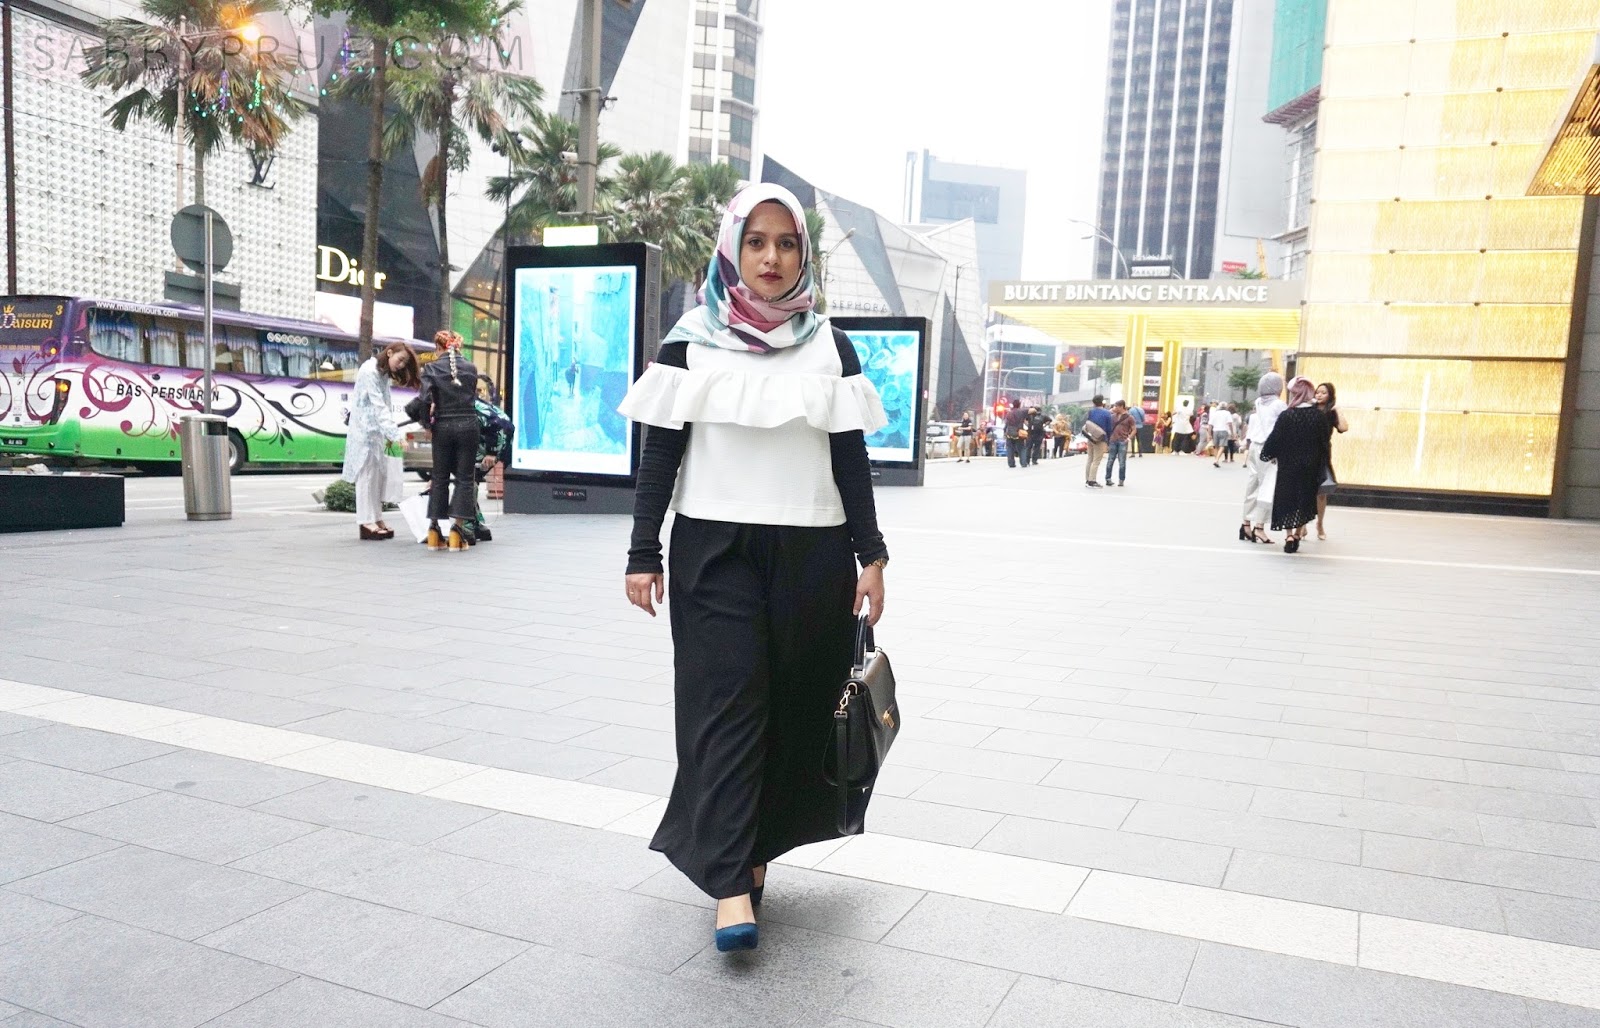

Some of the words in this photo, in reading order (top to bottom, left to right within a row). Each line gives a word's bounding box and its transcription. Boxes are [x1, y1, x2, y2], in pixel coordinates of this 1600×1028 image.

[1004, 285, 1061, 301] BUKIT
[1065, 285, 1152, 301] BINTANG
[1157, 285, 1268, 302] ENTRANCE
[55, 304, 63, 316] 3
[831, 300, 888, 313] SEPHORA
[116, 384, 142, 397] BAS
[151, 386, 220, 401] PERSIARN
